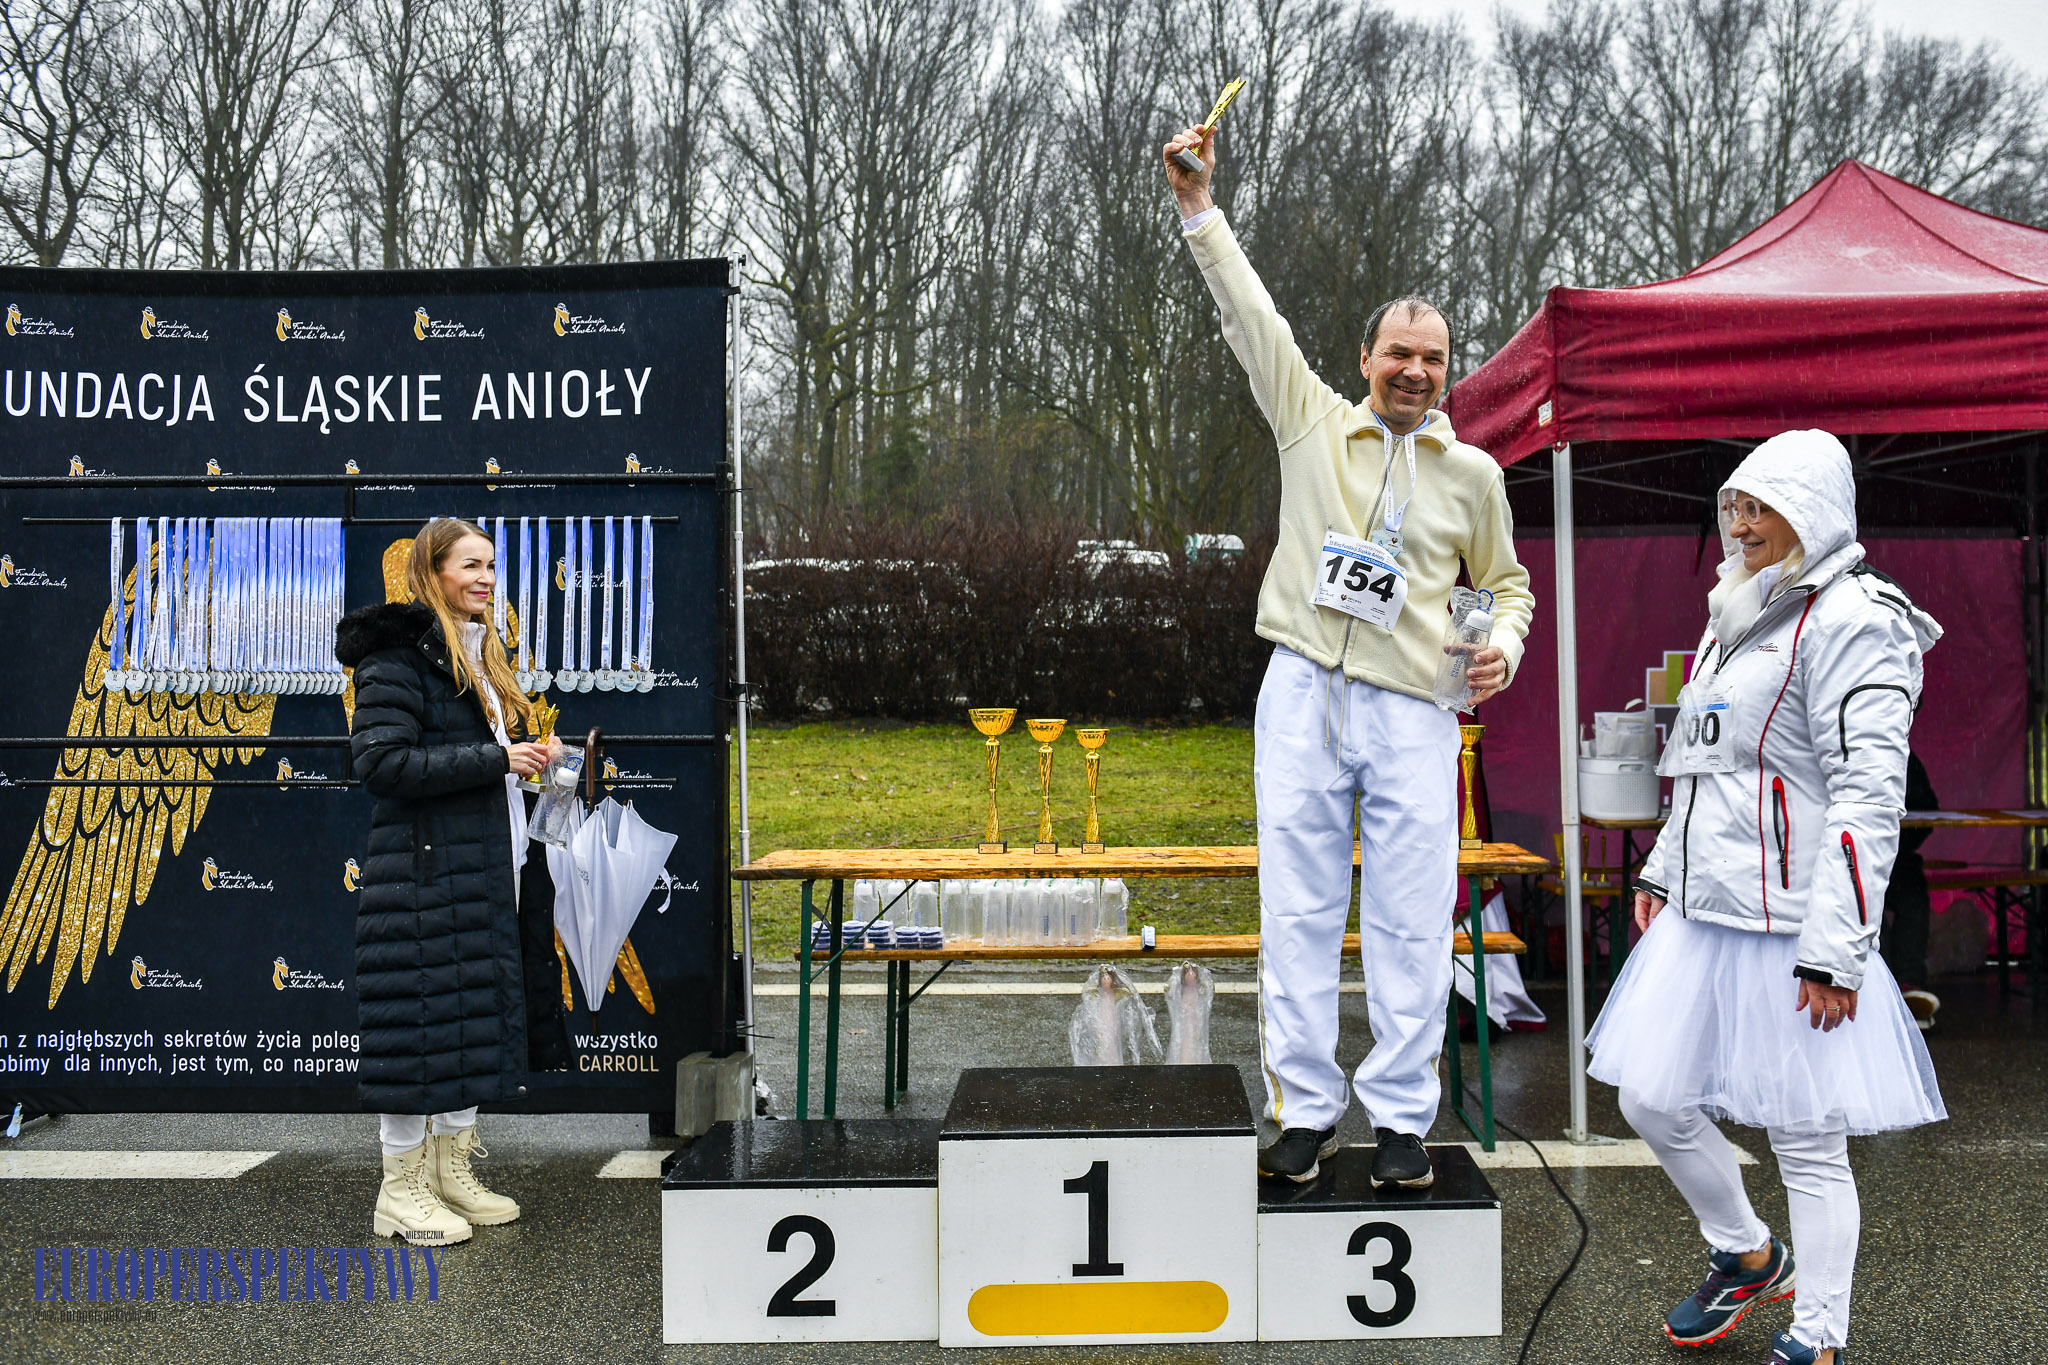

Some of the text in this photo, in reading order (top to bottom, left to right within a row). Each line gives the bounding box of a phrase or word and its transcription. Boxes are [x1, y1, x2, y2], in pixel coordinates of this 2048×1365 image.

[5, 363, 652, 435] UNDACJA ŚLĄSKIE ANIOŁY
[1326, 555, 1397, 603] 154
[0, 1053, 360, 1077] obimy dla innych, jest tym, co napraw
[17, 1034, 27, 1048] z
[37, 1029, 154, 1052] najgłębszych
[164, 1029, 247, 1048] sekretów
[256, 1029, 301, 1052] życia
[312, 1030, 360, 1053] poleg
[574, 1030, 658, 1053] wszystko
[579, 1054, 660, 1073] CARROLL
[1063, 1160, 1124, 1277] 1
[766, 1214, 836, 1317] 2
[1345, 1221, 1417, 1328] 3
